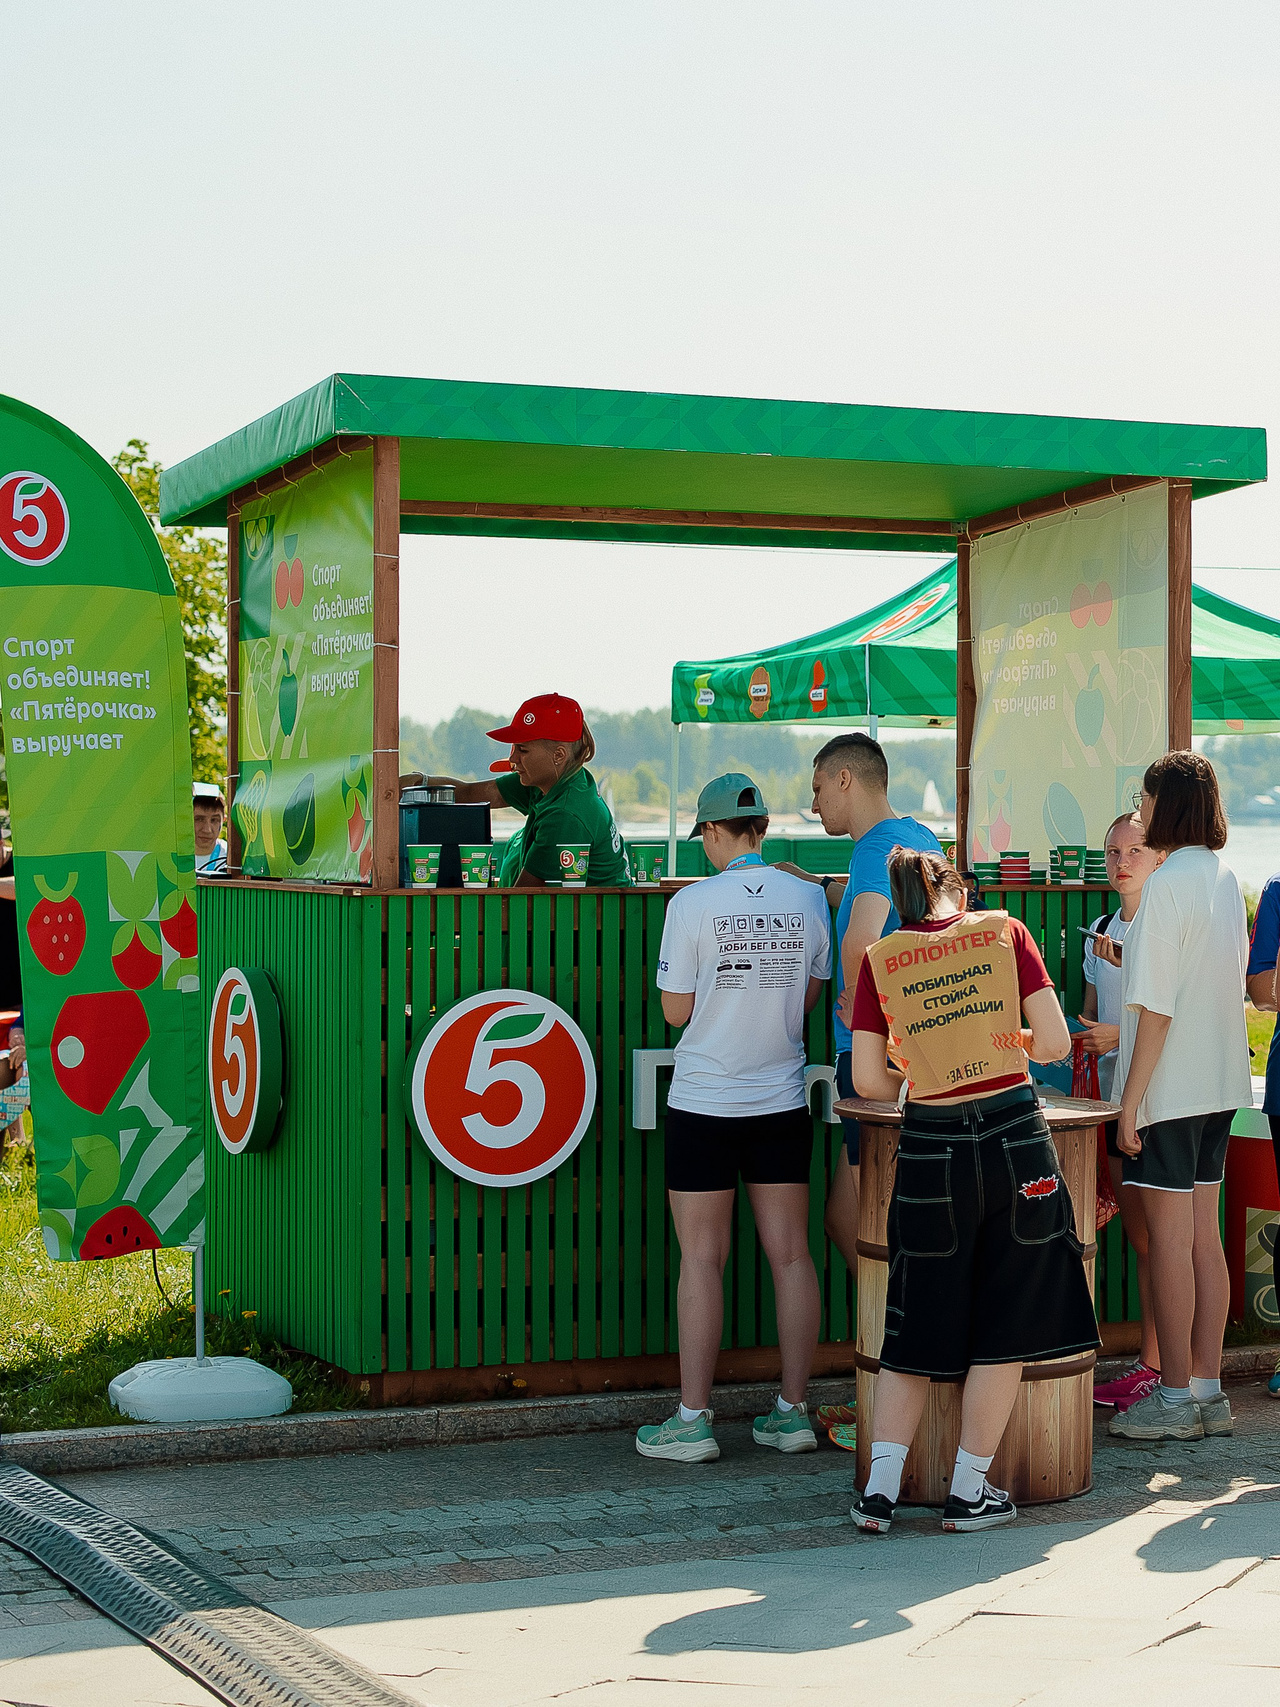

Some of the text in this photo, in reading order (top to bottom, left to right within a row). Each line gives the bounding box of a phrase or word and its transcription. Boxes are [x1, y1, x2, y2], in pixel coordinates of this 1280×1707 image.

[312, 564, 341, 589] Спорт
[312, 590, 372, 621] объединяет!
[3, 637, 75, 660] Спорт
[7, 666, 151, 690] объединяет!
[311, 669, 360, 696] выручает
[10, 697, 157, 723] «Пятёрочка»
[11, 732, 125, 757] выручает
[751, 942, 768, 950] БЕГ
[771, 941, 777, 949] В
[780, 941, 804, 949] СЕБЕ
[885, 930, 996, 975] ВОЛОНТЕР
[902, 964, 992, 997] МОБИЛЬНАЯ
[923, 984, 979, 1010] СТОЙКА
[906, 1000, 1003, 1035] ИНФОРМАЦИИ
